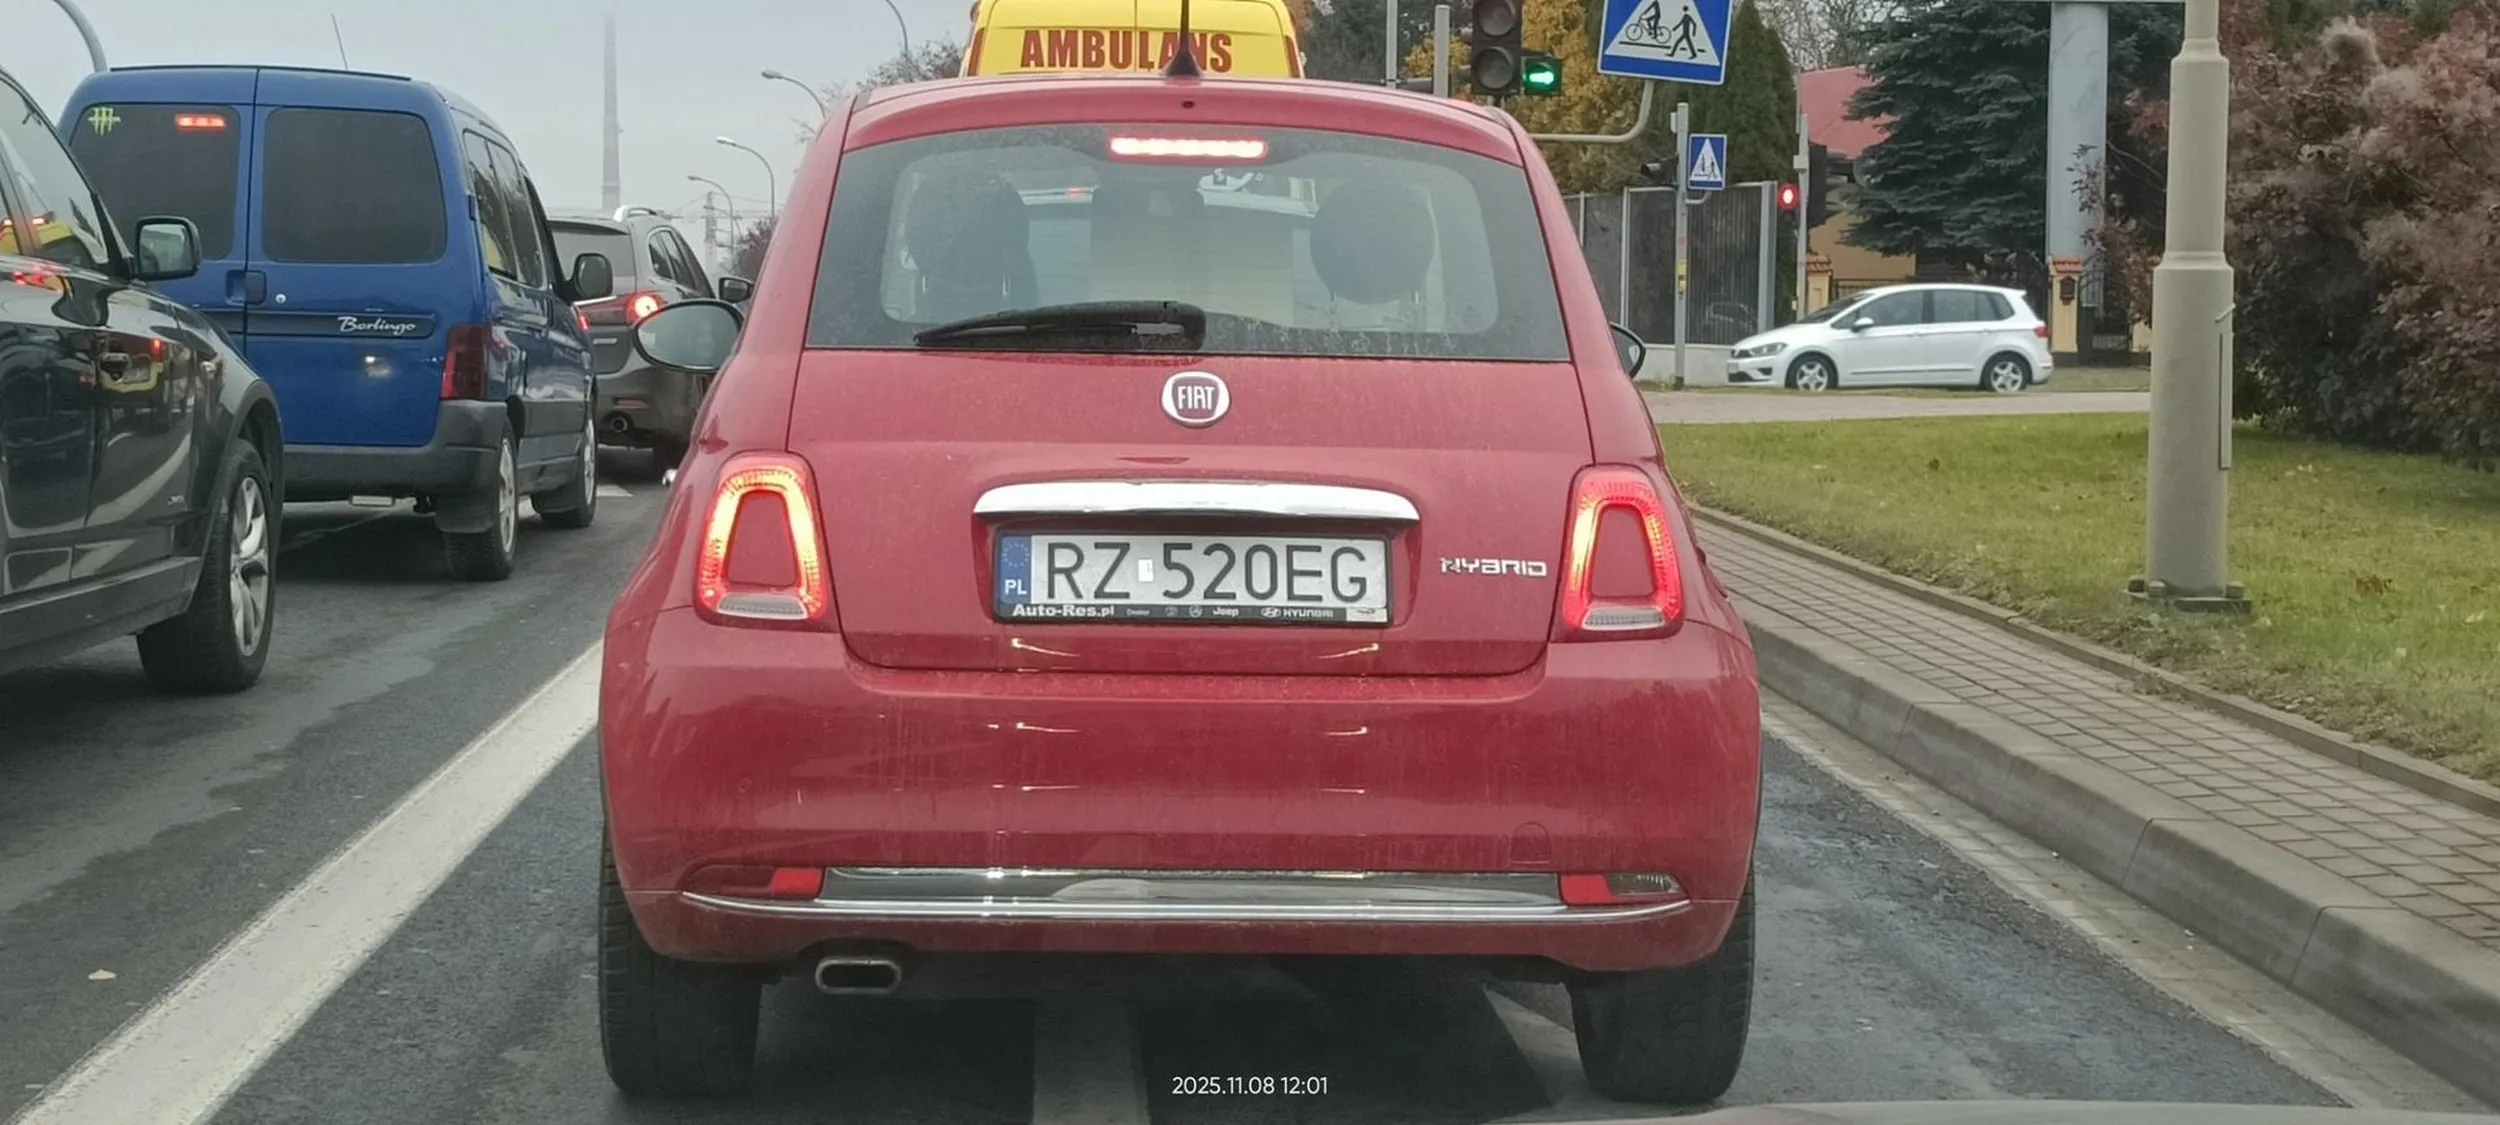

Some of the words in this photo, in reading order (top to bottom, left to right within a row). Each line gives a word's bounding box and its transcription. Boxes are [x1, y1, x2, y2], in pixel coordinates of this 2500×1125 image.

[1020, 29, 1232, 73] AMBULANS
[337, 316, 416, 336] Berlingo
[1177, 385, 1215, 410] FIAT
[1047, 541, 1131, 599] RZ
[1162, 542, 1368, 603] 520EG
[1440, 557, 1547, 577] HYBRID
[1004, 579, 1027, 595] PL
[1012, 603, 1115, 617] Auto-Res.pl
